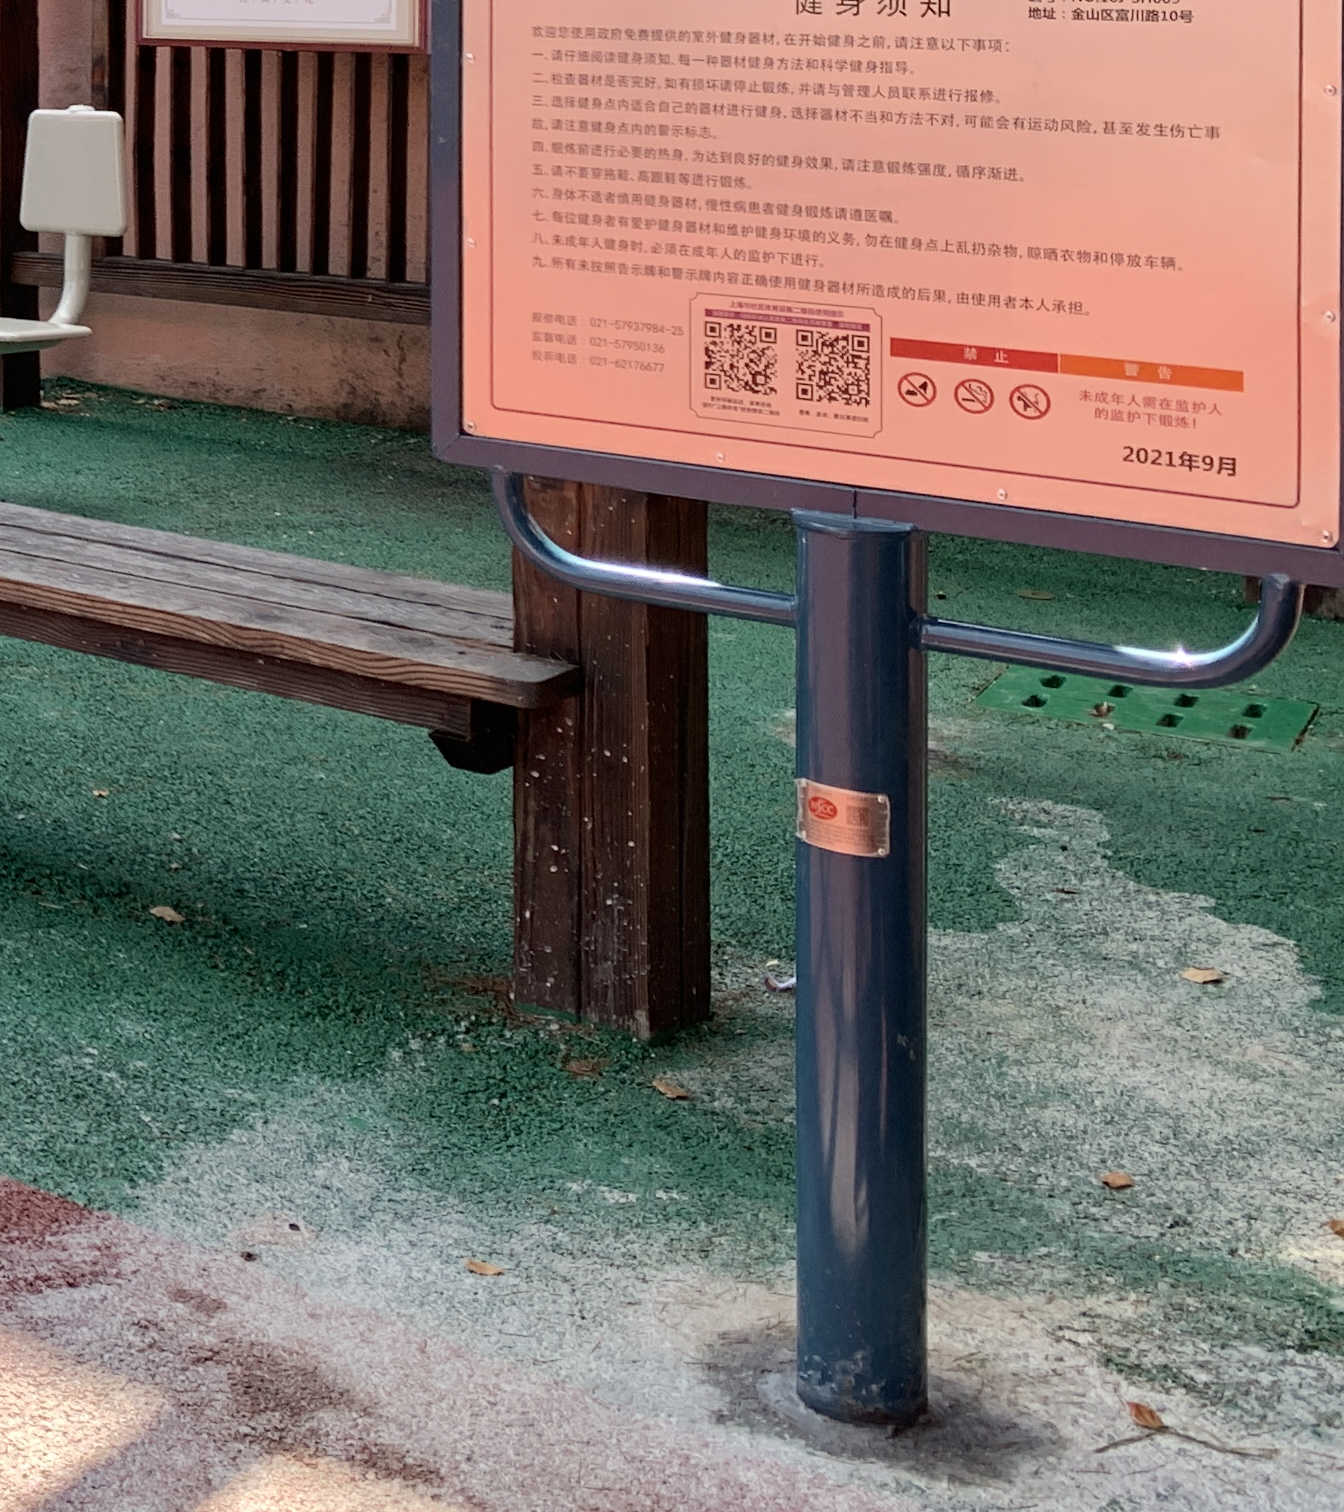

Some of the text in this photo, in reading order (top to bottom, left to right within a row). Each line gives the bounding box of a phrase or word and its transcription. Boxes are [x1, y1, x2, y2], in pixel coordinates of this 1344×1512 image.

[1079, 389, 1223, 416] 未成年人需在监护人
[1122, 445, 1238, 478] 2021年9月
